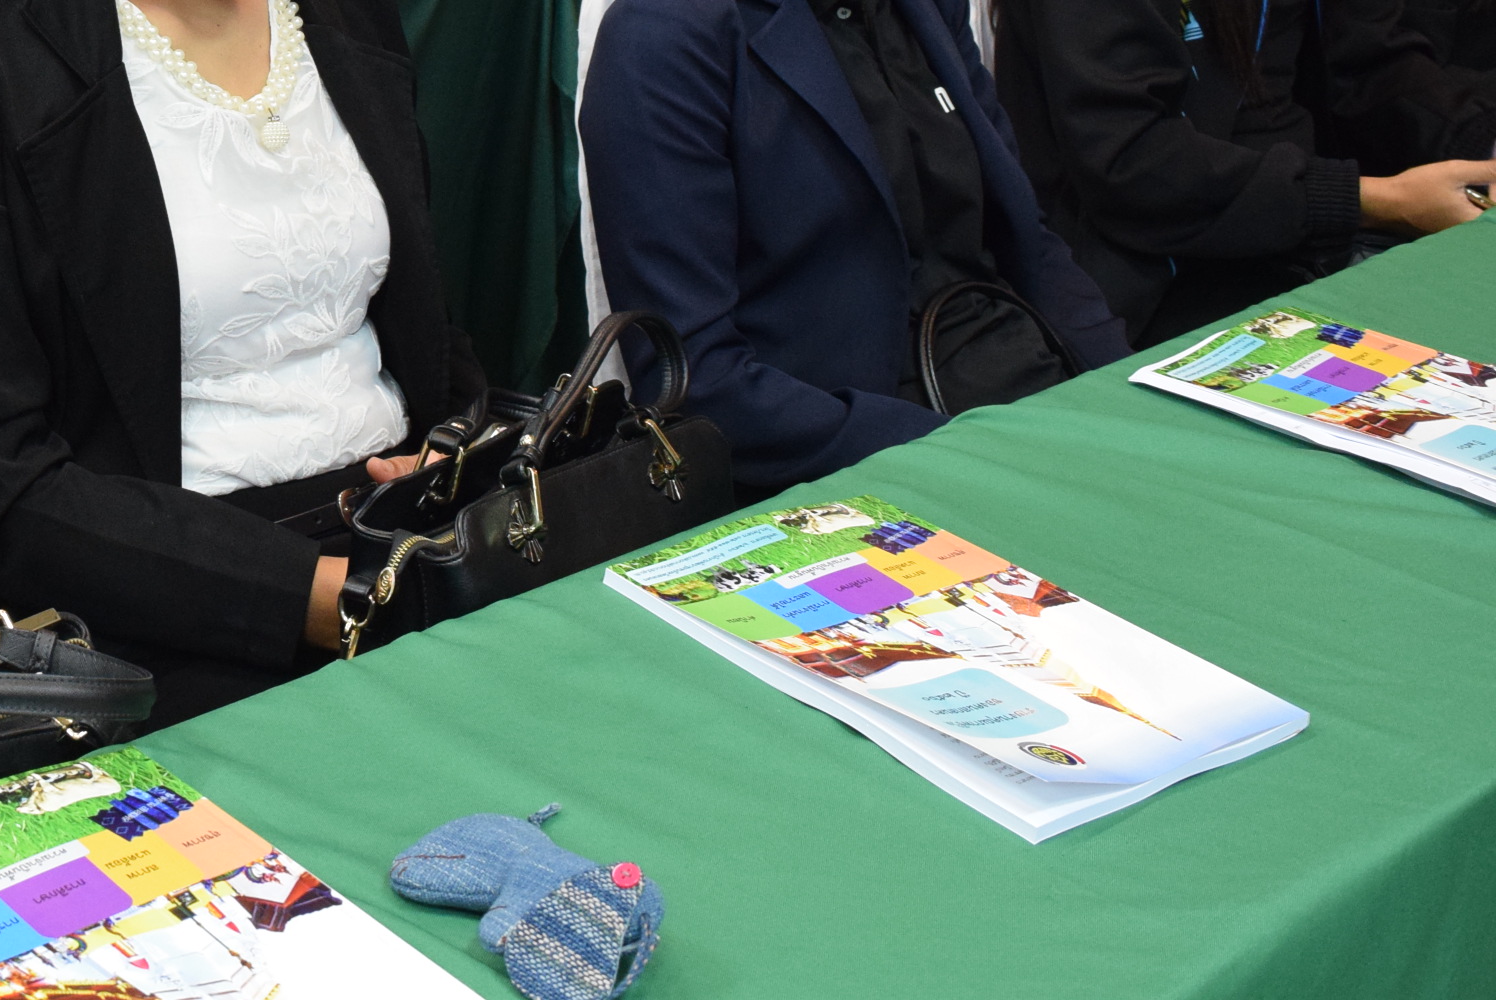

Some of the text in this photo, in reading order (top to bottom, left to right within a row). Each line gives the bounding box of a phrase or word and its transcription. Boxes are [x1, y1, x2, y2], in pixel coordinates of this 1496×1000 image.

[180, 830, 223, 848] สุขภาพ
[102, 848, 152, 870] แวดล้อม
[124, 863, 161, 880] สภาพ
[31, 878, 88, 905] การศึกษา
